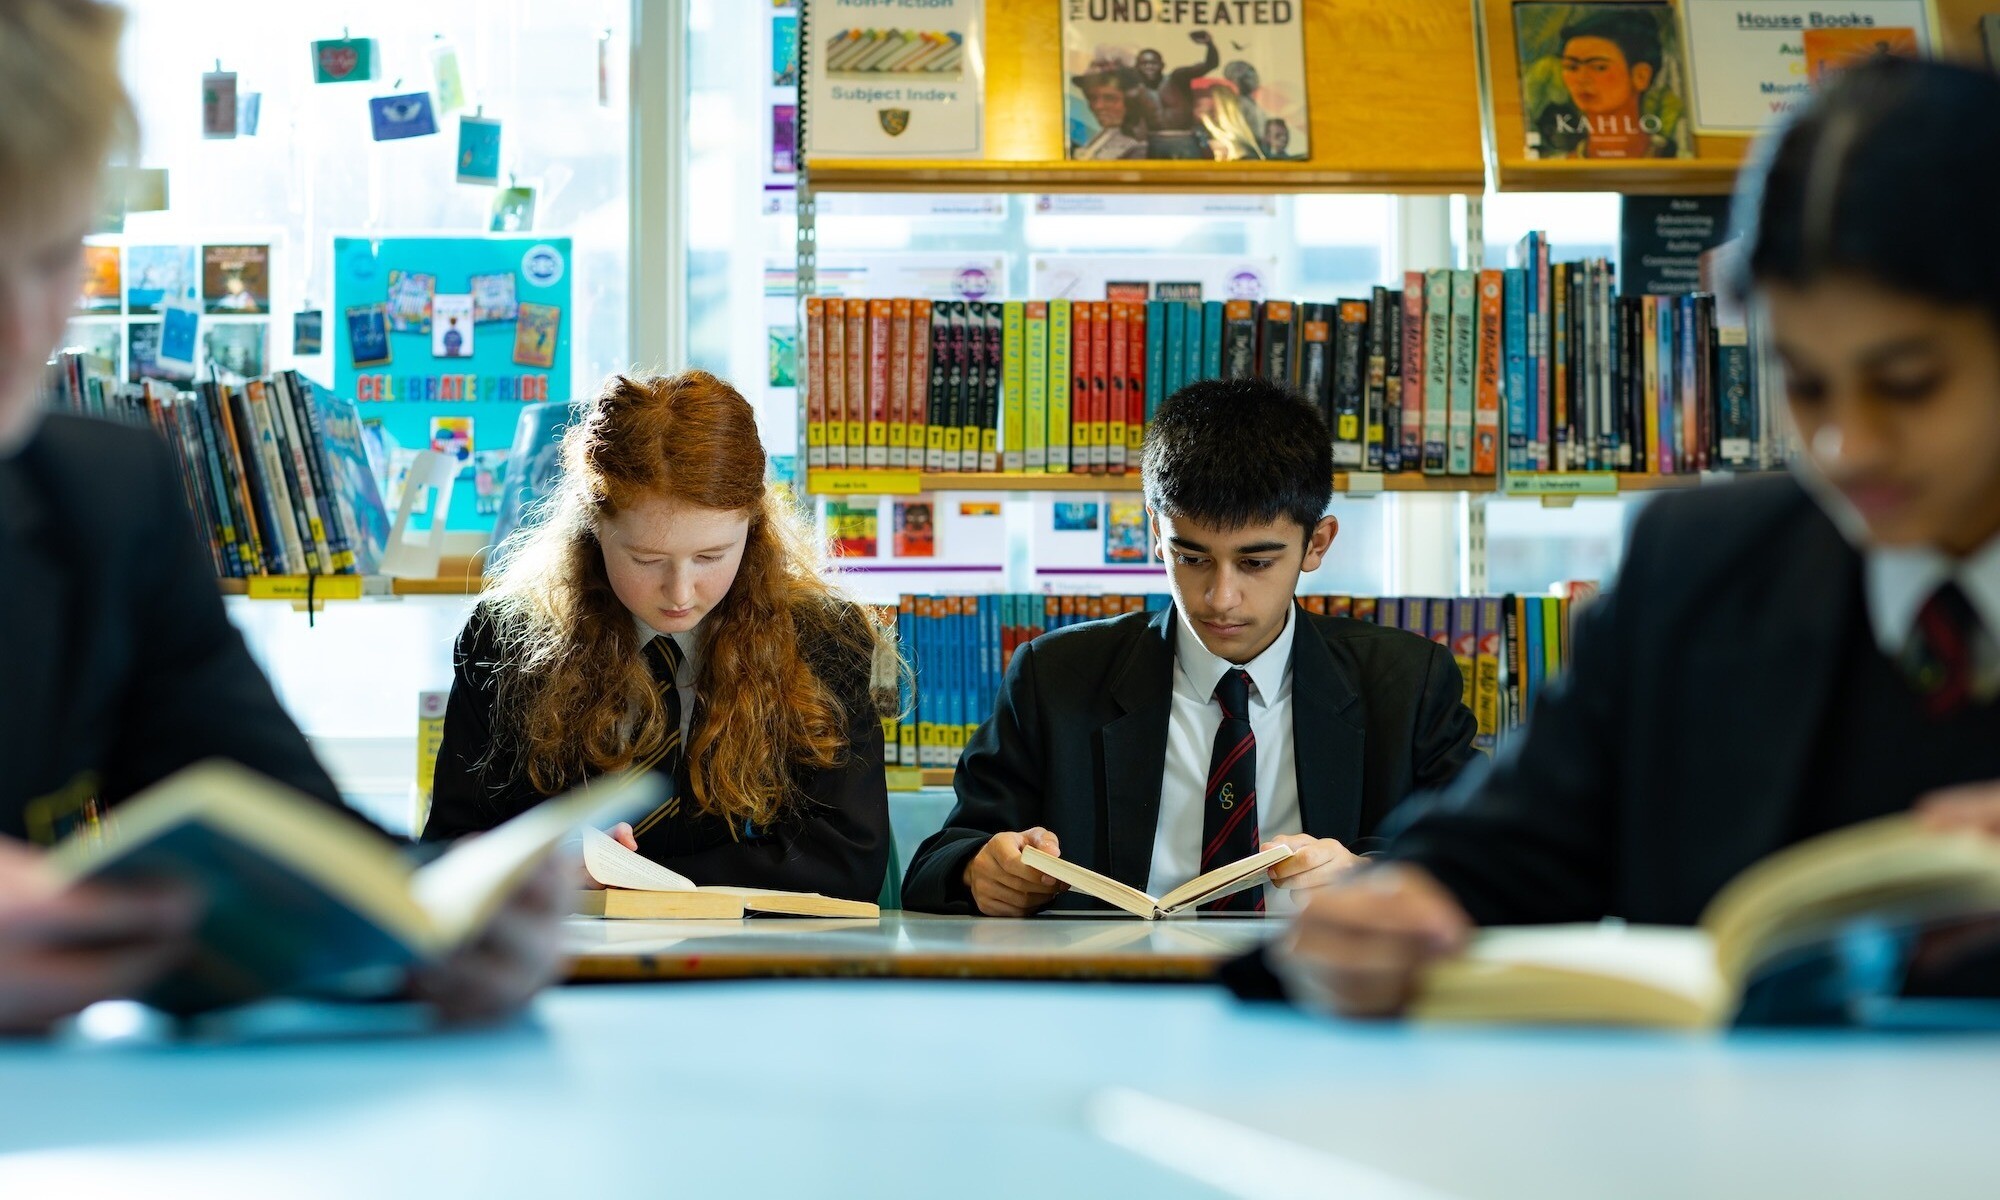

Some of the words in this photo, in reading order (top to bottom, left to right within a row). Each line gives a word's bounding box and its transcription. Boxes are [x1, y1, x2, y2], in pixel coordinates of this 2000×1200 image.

[1088, 0, 1293, 25] UNDEFEATED
[1737, 12, 1802, 27] House
[1809, 12, 1875, 27] Books
[832, 86, 901, 102] Subject
[906, 88, 957, 101] Index
[1555, 113, 1663, 134] KAHLO
[357, 374, 477, 401] CELEBRATE
[484, 374, 549, 401] PRIDE
